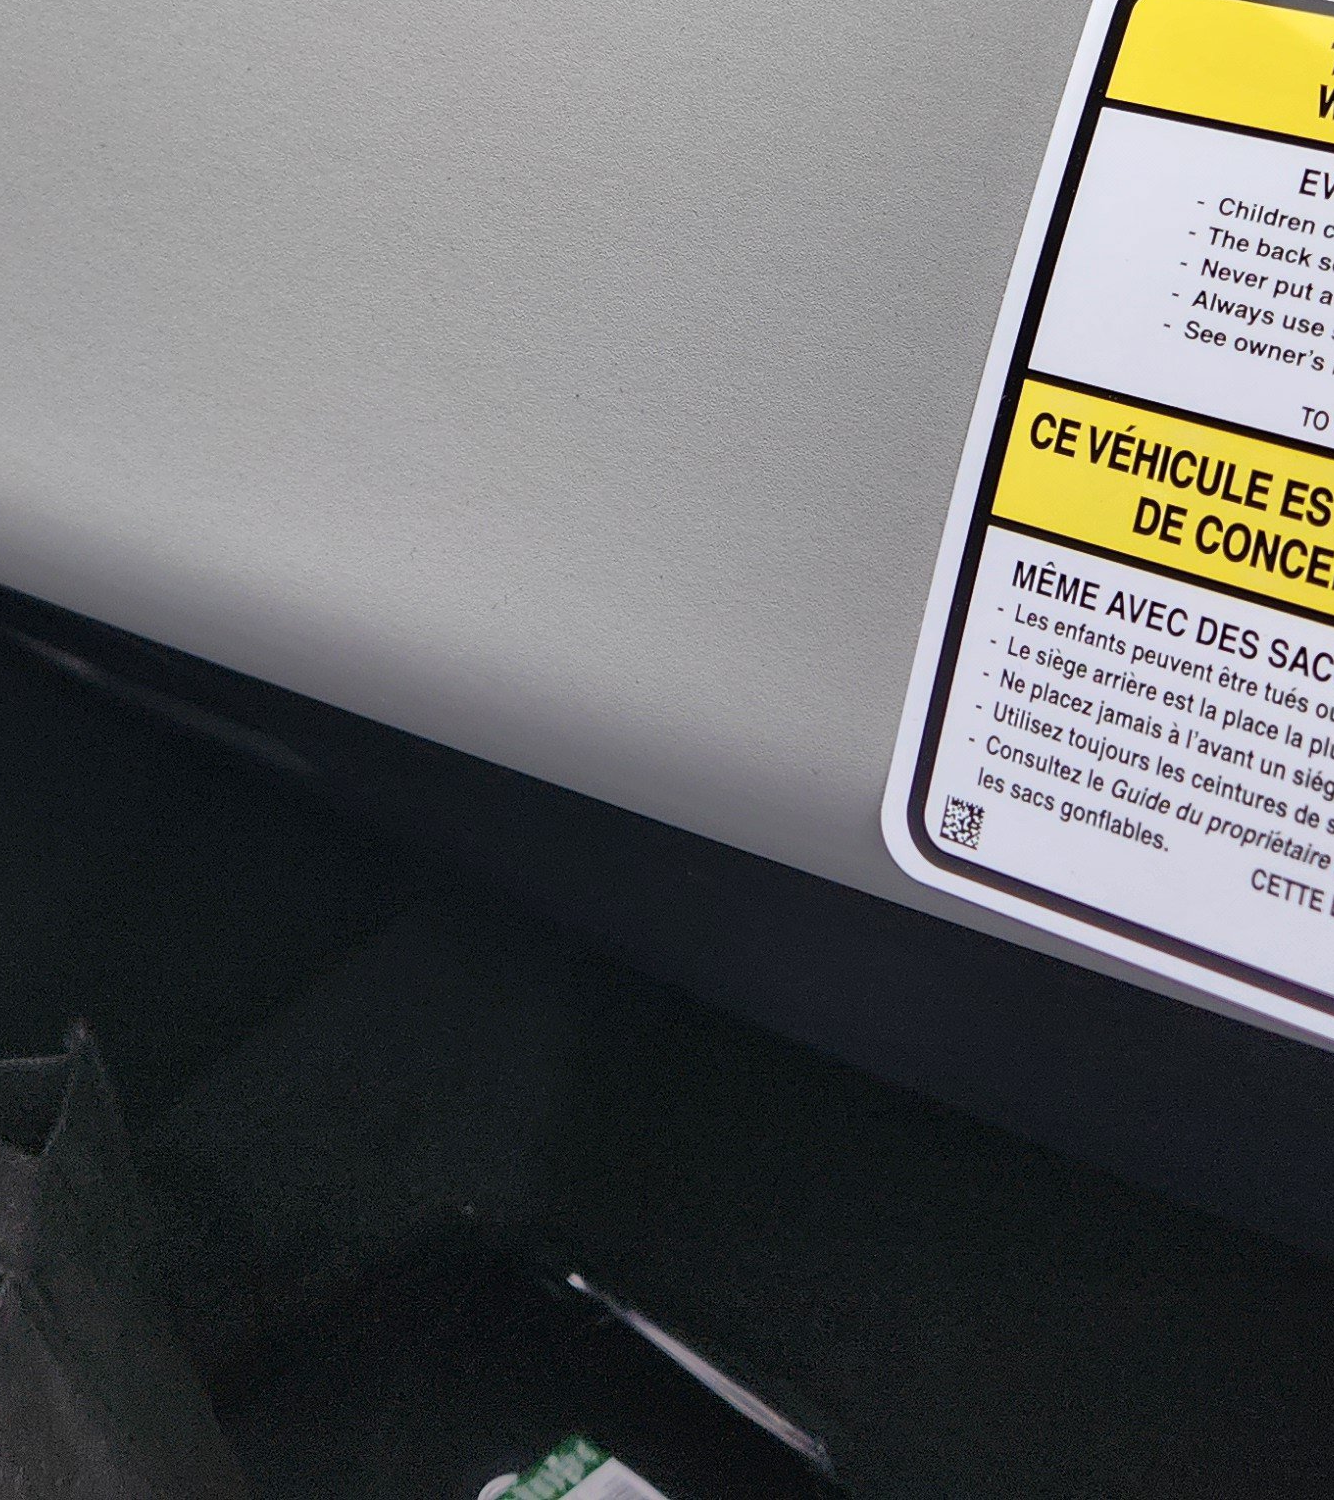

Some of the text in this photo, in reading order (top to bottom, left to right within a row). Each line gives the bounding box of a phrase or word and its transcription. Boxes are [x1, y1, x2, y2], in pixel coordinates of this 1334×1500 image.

[1207, 224, 1251, 254] The
[1254, 236, 1314, 270] back
[1217, 196, 1317, 237] Children
[1189, 288, 1276, 328] Always
[1280, 313, 1326, 339] use
[1199, 256, 1271, 291] Never
[1271, 277, 1315, 303] put
[1317, 288, 1334, 308] a
[1182, 318, 1228, 348] See
[1232, 335, 1327, 373] owner's
[1300, 404, 1331, 433] TO
[1028, 410, 1084, 460] CE
[1088, 423, 1275, 513] VÉHICULE
[1130, 494, 1190, 547] DE
[1010, 558, 1102, 613] MÊME
[1103, 589, 1190, 639] AVEC
[1193, 614, 1262, 661] DES
[1006, 634, 1032, 662] Le
[1033, 646, 1089, 682] siège
[1091, 666, 1159, 703] arrière
[1161, 689, 1196, 716] est
[1197, 695, 1219, 723] la
[1220, 707, 1280, 742] place
[1283, 722, 1305, 751] la
[1013, 601, 1051, 633] Les
[1052, 619, 1128, 657] enfants
[1128, 643, 1215, 686] peuvent
[1216, 664, 1260, 698] être
[1263, 680, 1311, 715] tués
[998, 667, 1027, 696] Ne
[1027, 680, 1095, 719] placez
[1093, 698, 1164, 741] jamais
[1166, 720, 1182, 748] à
[1184, 727, 1256, 772] l'avant
[1258, 756, 1288, 782] un
[992, 699, 1066, 745] Utilisez
[1066, 725, 1152, 773] toujours
[1154, 754, 1187, 785] les
[1189, 771, 1290, 820] ceintures
[1292, 802, 1322, 831] de
[976, 765, 1170, 854] les sacs gonflables.
[984, 733, 1084, 787] Consultez
[1085, 767, 1106, 794] le
[1109, 777, 1172, 816] Guide
[1174, 801, 1206, 828] du
[1203, 814, 1333, 872] propriétaire
[1249, 866, 1327, 915] CETTE
